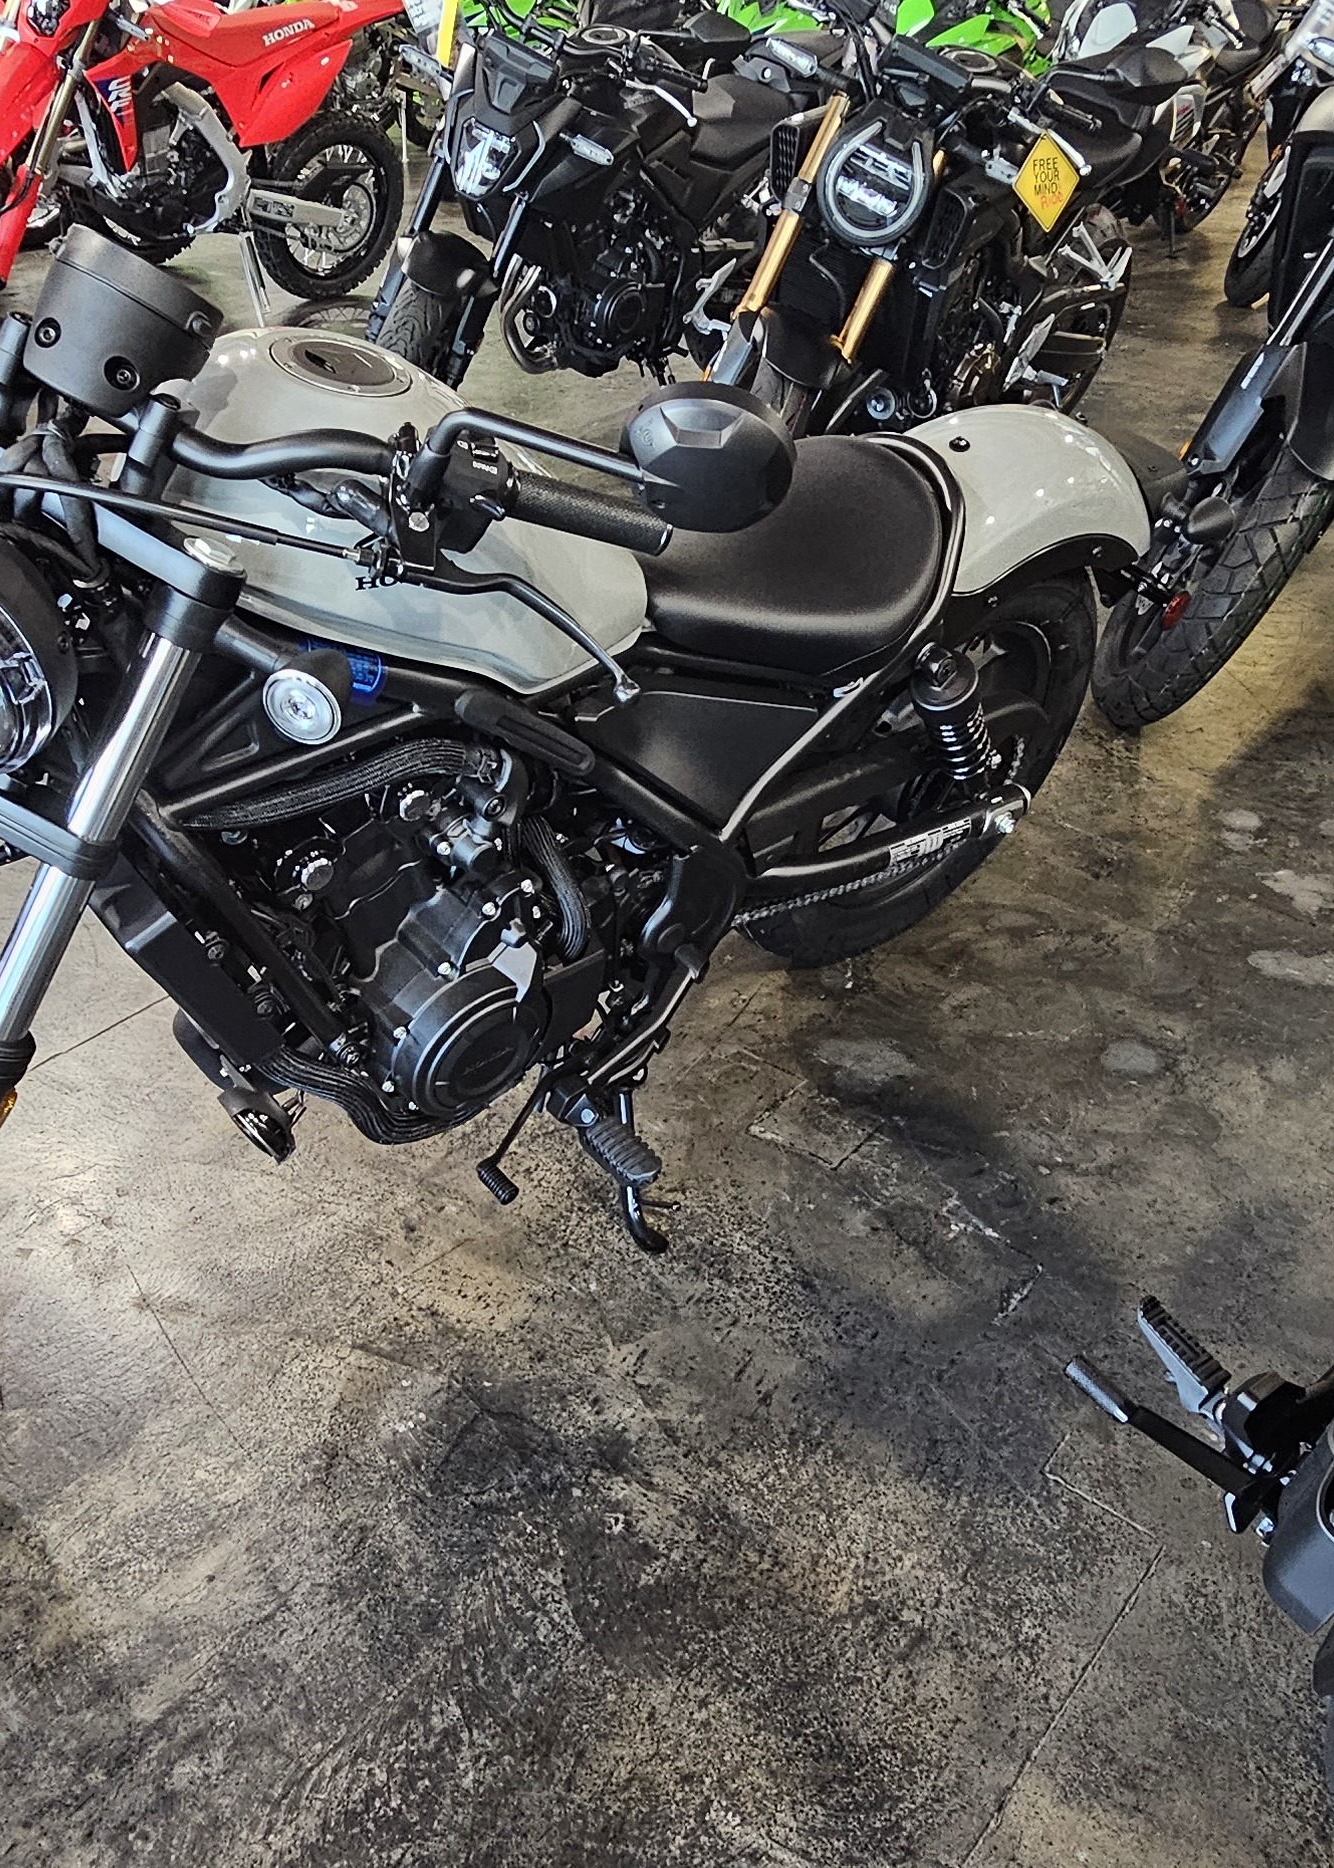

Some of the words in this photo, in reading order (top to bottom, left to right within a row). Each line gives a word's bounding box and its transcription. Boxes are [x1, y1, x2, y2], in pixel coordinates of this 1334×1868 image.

[261, 19, 315, 47] HONDA
[1033, 157, 1059, 173] FREE
[1034, 170, 1060, 183] YOUR
